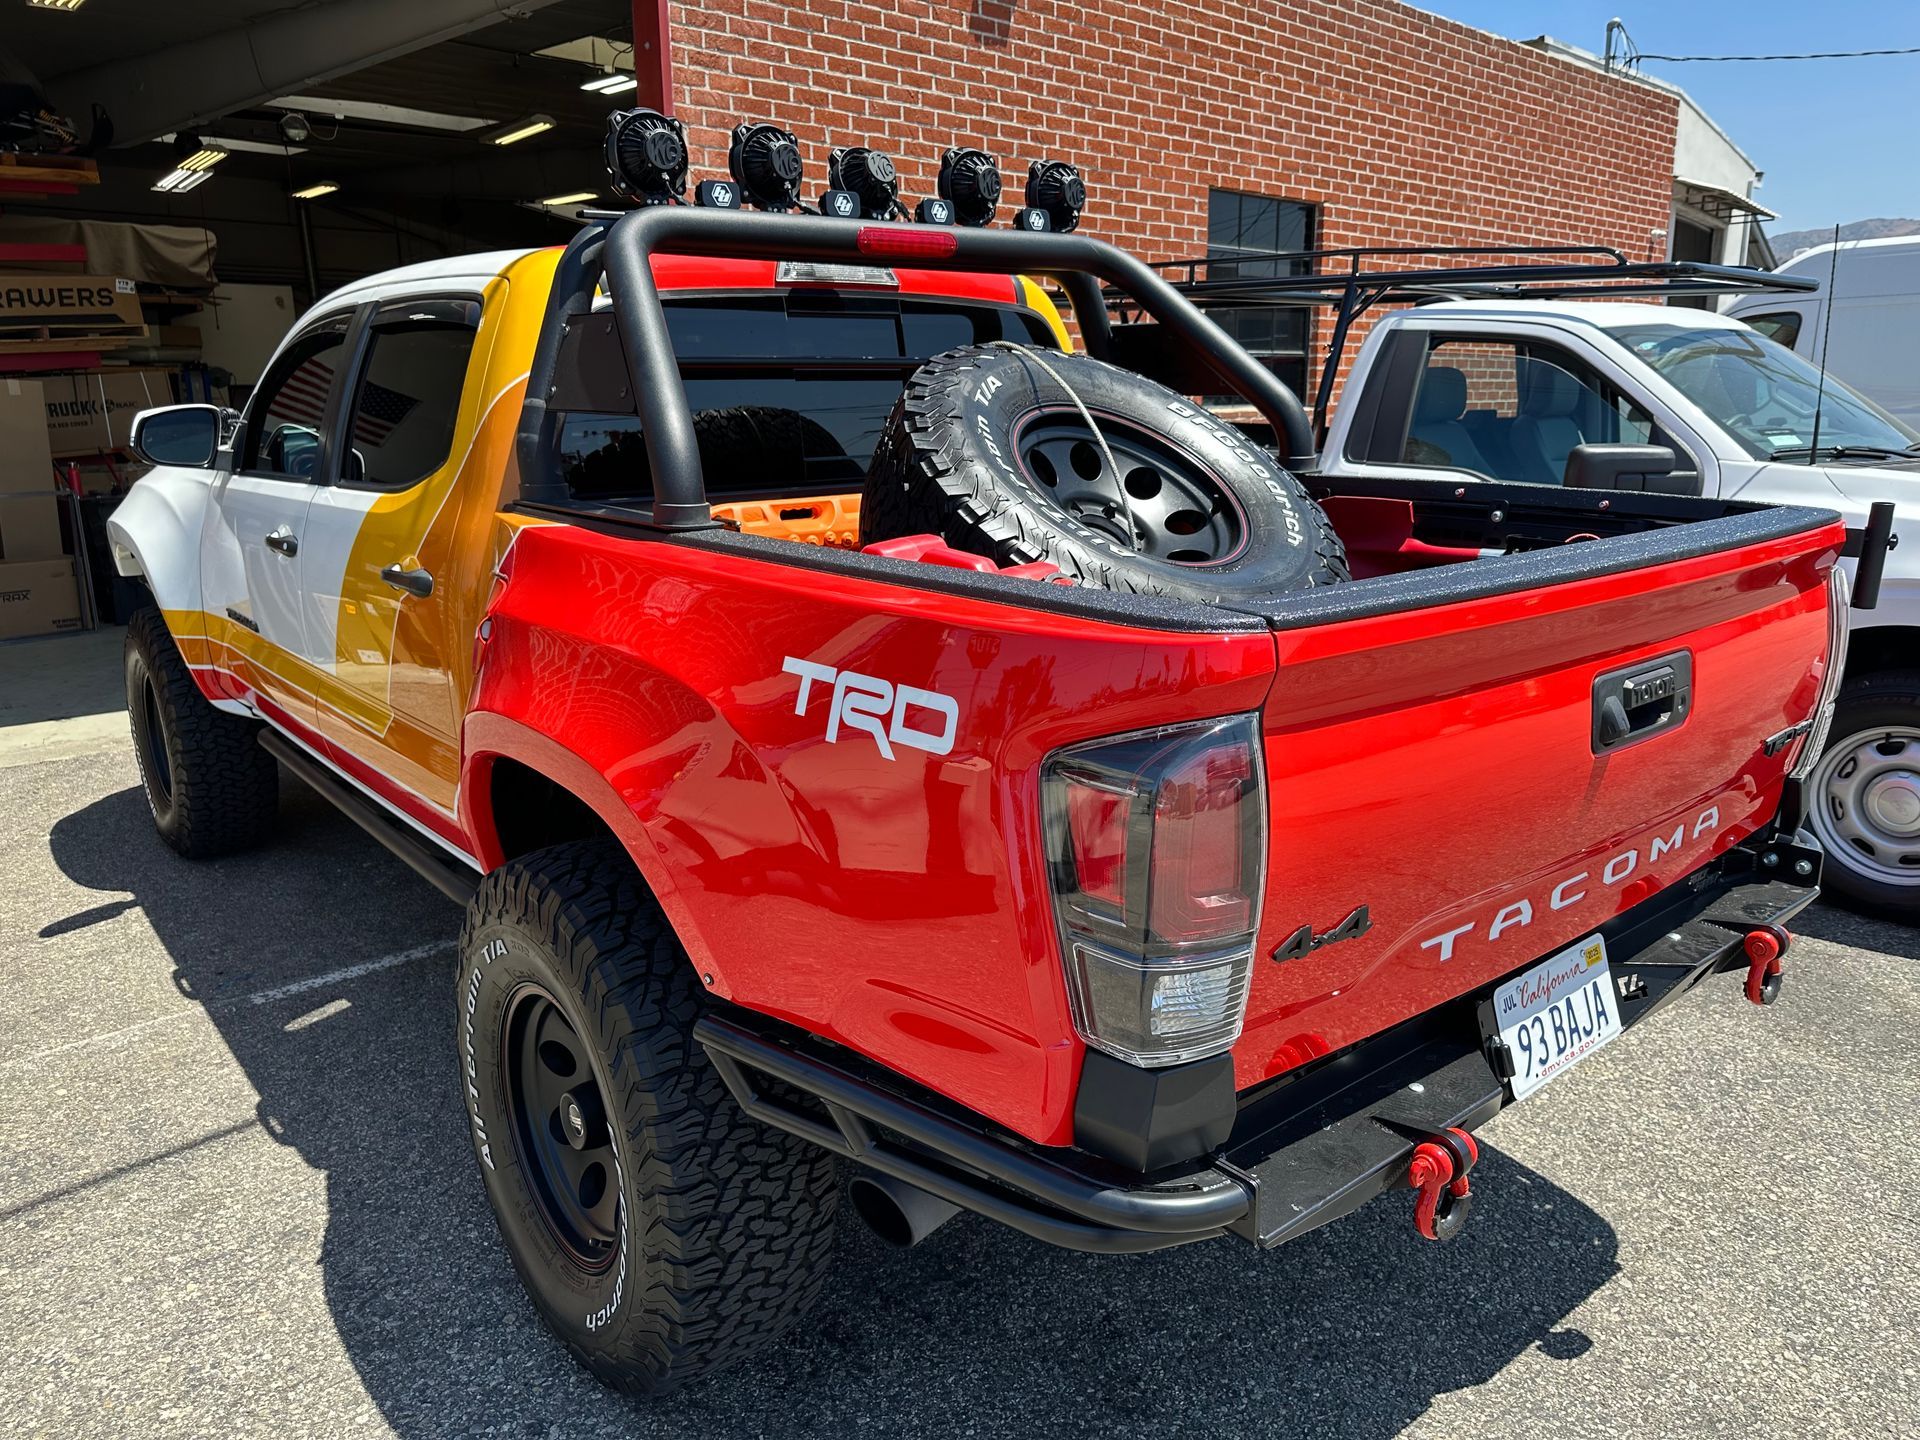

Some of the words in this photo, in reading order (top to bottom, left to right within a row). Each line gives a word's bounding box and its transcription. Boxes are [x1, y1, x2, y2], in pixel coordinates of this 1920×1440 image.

[974, 375, 1003, 406] T/A
[1166, 401, 1304, 547] BFGoodrich
[782, 655, 960, 762] TRD
[1632, 674, 1676, 704] TOYOTA
[1419, 804, 1721, 963] TACOMA
[1272, 903, 1375, 965] 4x4
[1503, 994, 1517, 1014] JUL
[1520, 960, 1588, 1009] California
[466, 966, 496, 1171] All-Terrain
[481, 939, 510, 965] T/A
[1517, 1015, 1550, 1079] 93
[1549, 980, 1609, 1057] BAJA
[1541, 1037, 1597, 1077] dmv.ca.gov
